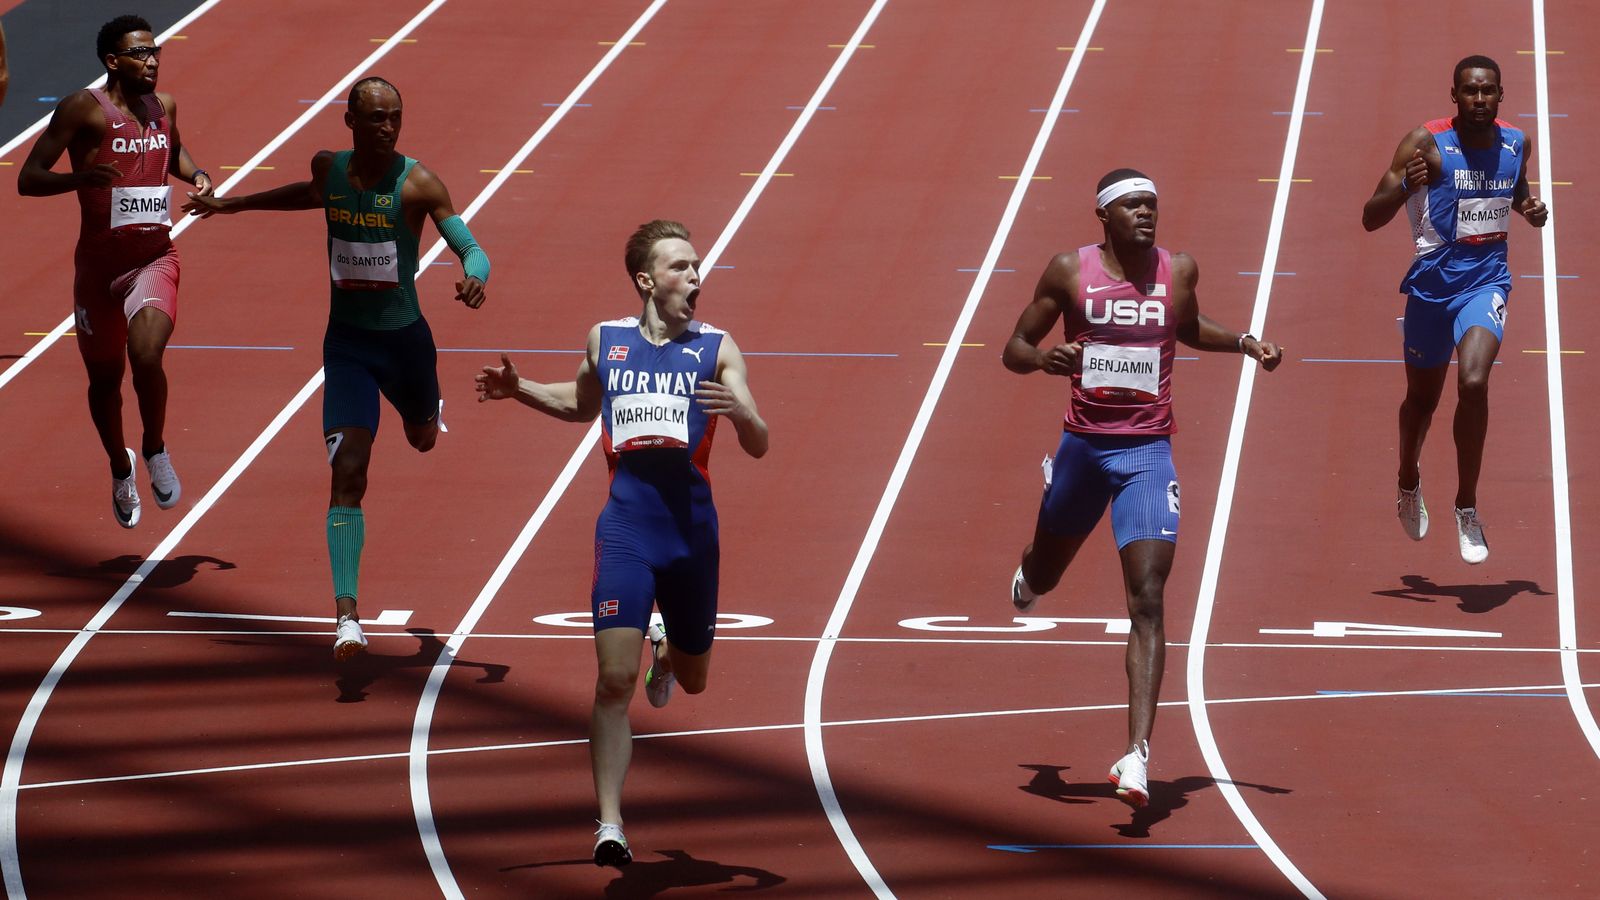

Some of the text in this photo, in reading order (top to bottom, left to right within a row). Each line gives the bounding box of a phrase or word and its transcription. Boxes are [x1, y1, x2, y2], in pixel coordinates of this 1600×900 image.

[112, 134, 167, 153] QATAR
[1455, 170, 1485, 180] BRITISH
[1455, 179, 1514, 190] VIRGIN ISLANDS
[120, 198, 167, 212] SAMBA
[1461, 206, 1509, 221] McMASTER
[328, 208, 394, 228] BRASIL
[337, 253, 390, 267] dos SANTOS
[1085, 299, 1165, 327] USA
[1090, 357, 1153, 374] BENJAMIN
[607, 368, 698, 395] NORWAY
[614, 406, 684, 425] WARHOLM
